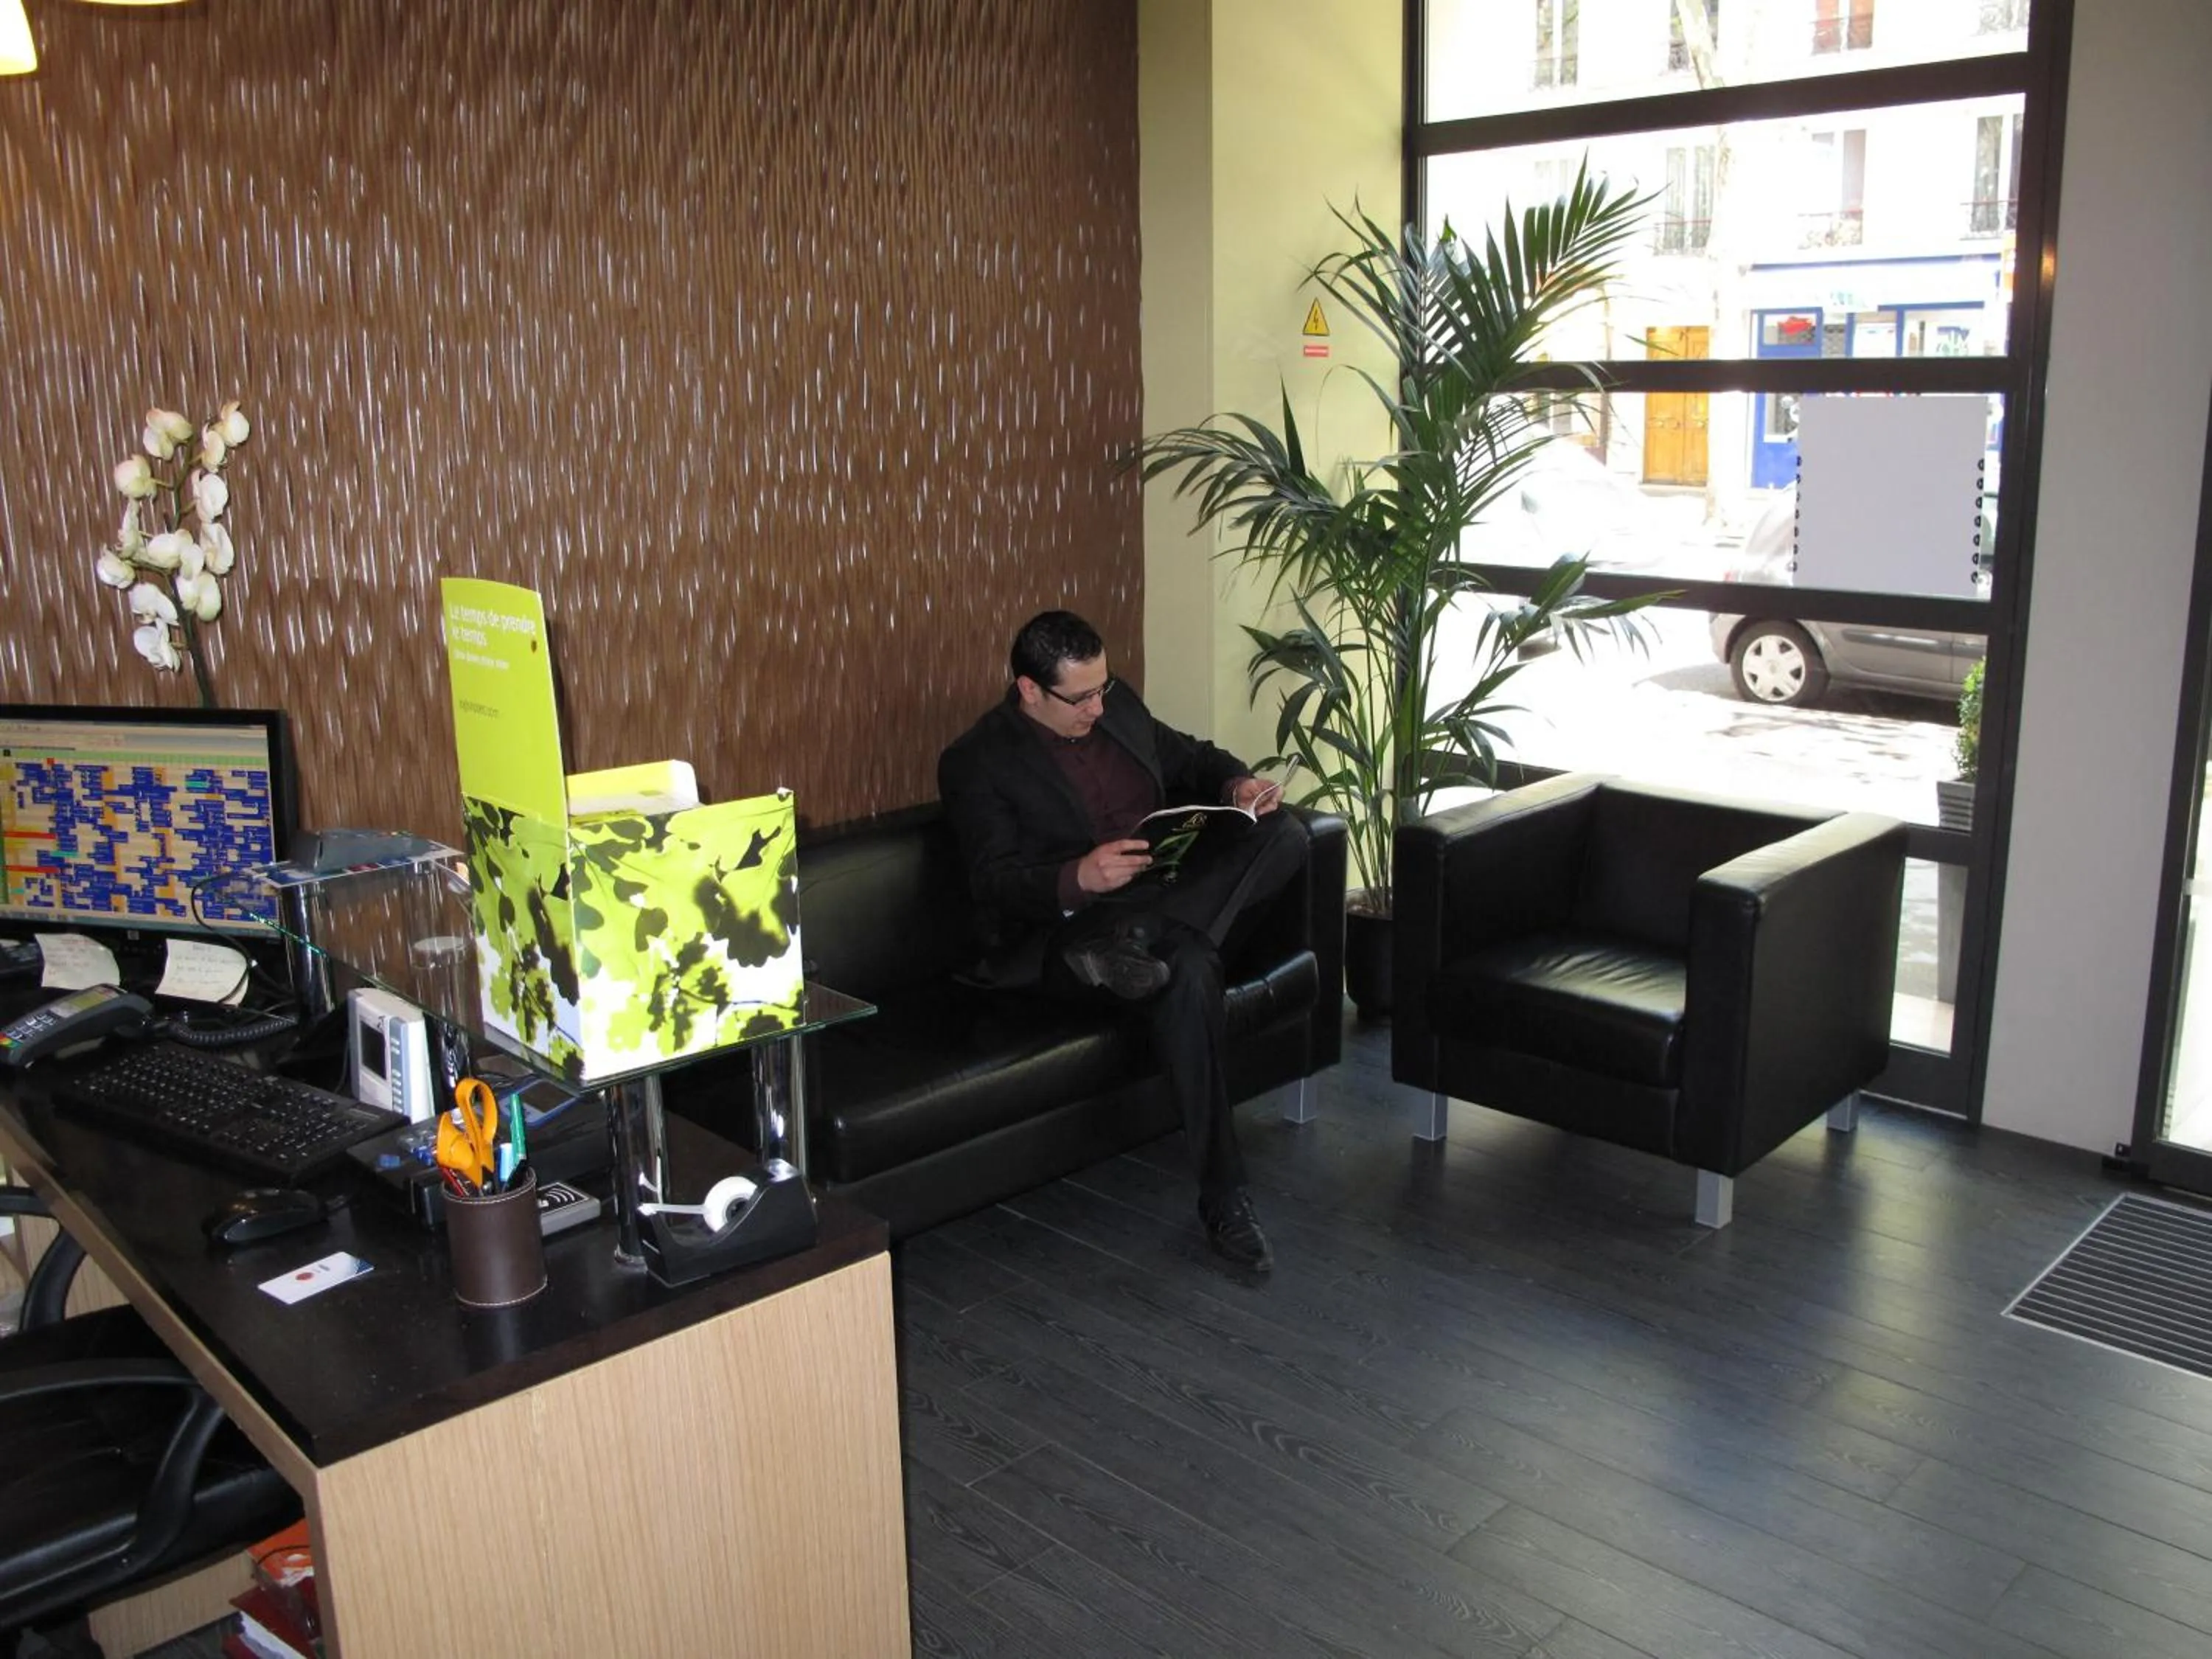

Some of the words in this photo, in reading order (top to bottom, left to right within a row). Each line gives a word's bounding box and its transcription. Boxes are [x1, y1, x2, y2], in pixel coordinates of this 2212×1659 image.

[449, 604, 459, 620] Le
[460, 605, 487, 627] temps
[487, 609, 500, 627] de
[461, 627, 487, 647] temps
